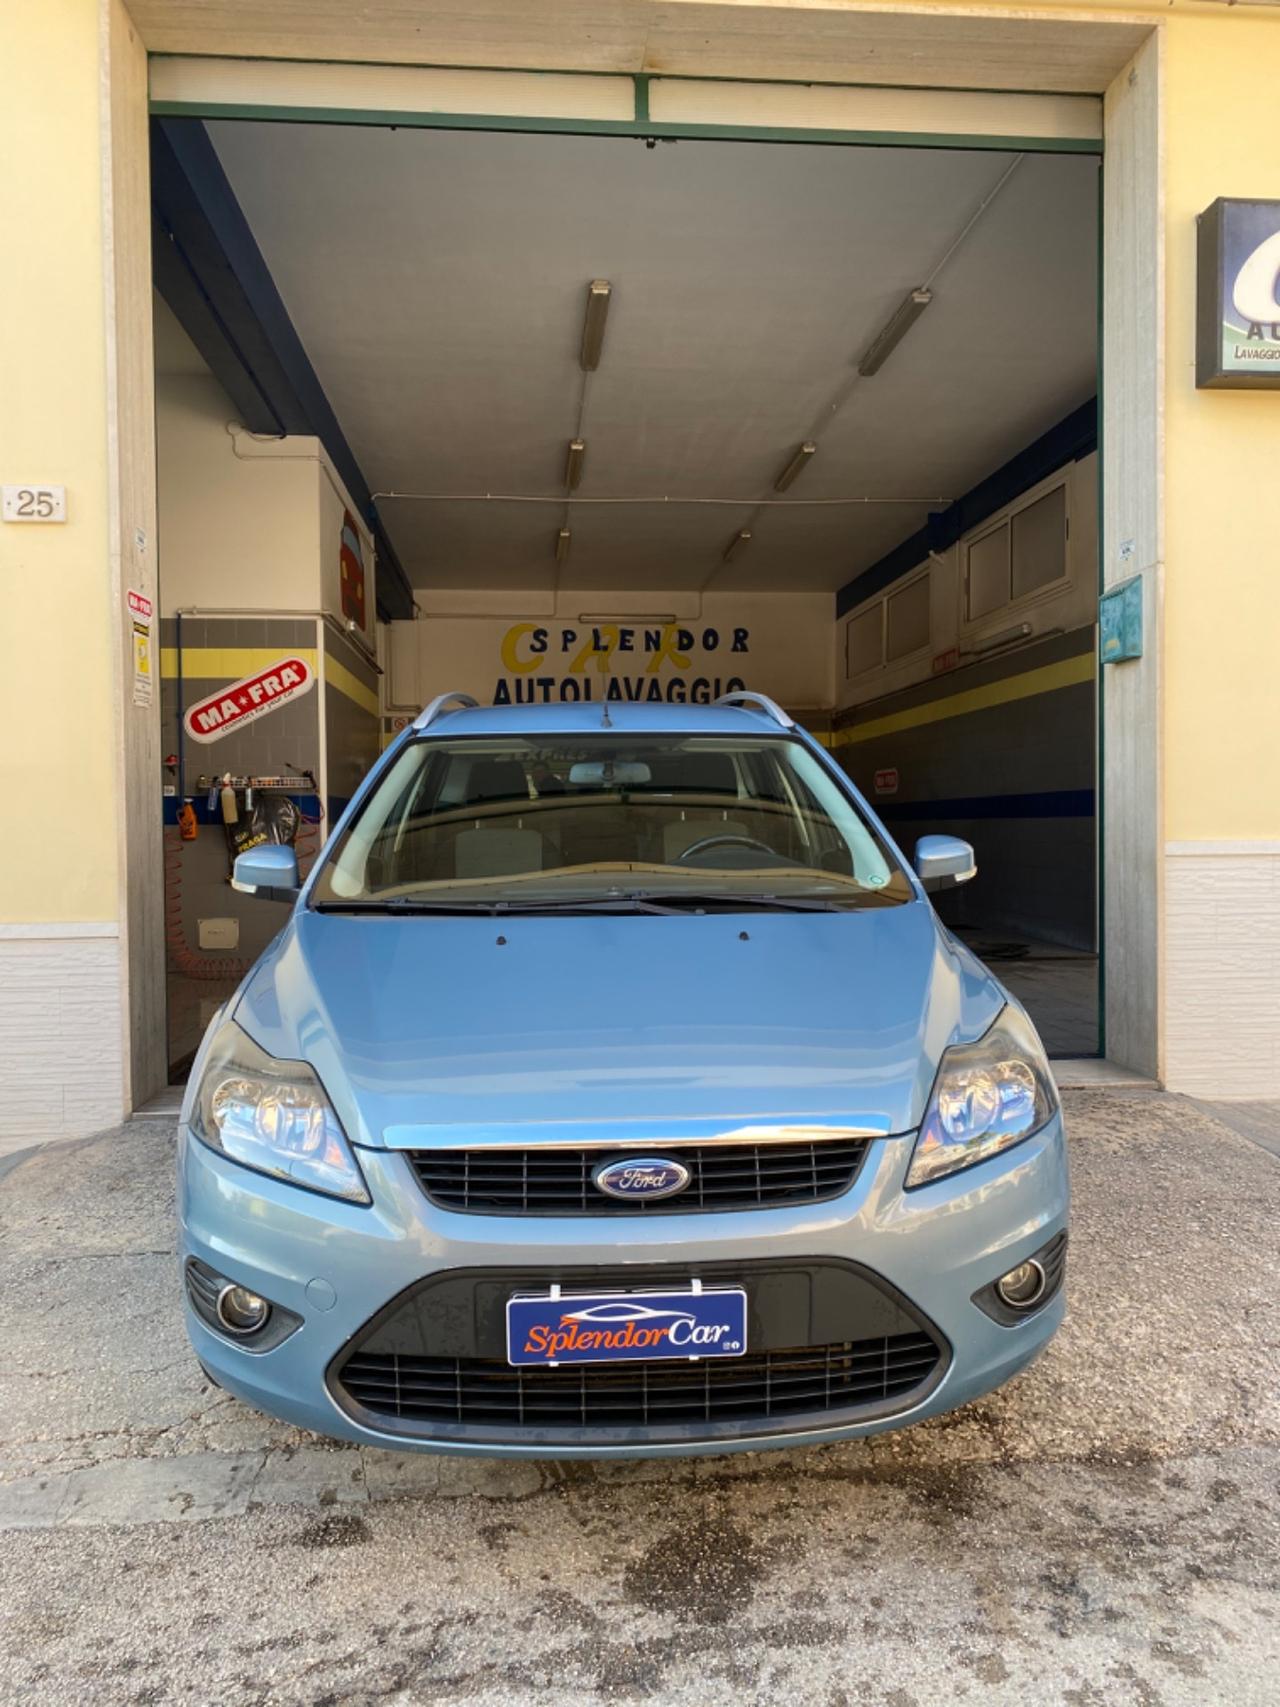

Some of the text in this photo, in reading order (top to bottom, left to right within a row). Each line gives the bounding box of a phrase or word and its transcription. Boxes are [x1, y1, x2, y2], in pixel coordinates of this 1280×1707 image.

[16, 490, 54, 517] 25
[501, 622, 693, 674] CAR
[529, 628, 750, 653] SPLENDOR
[619, 1167, 667, 1189] Ford
